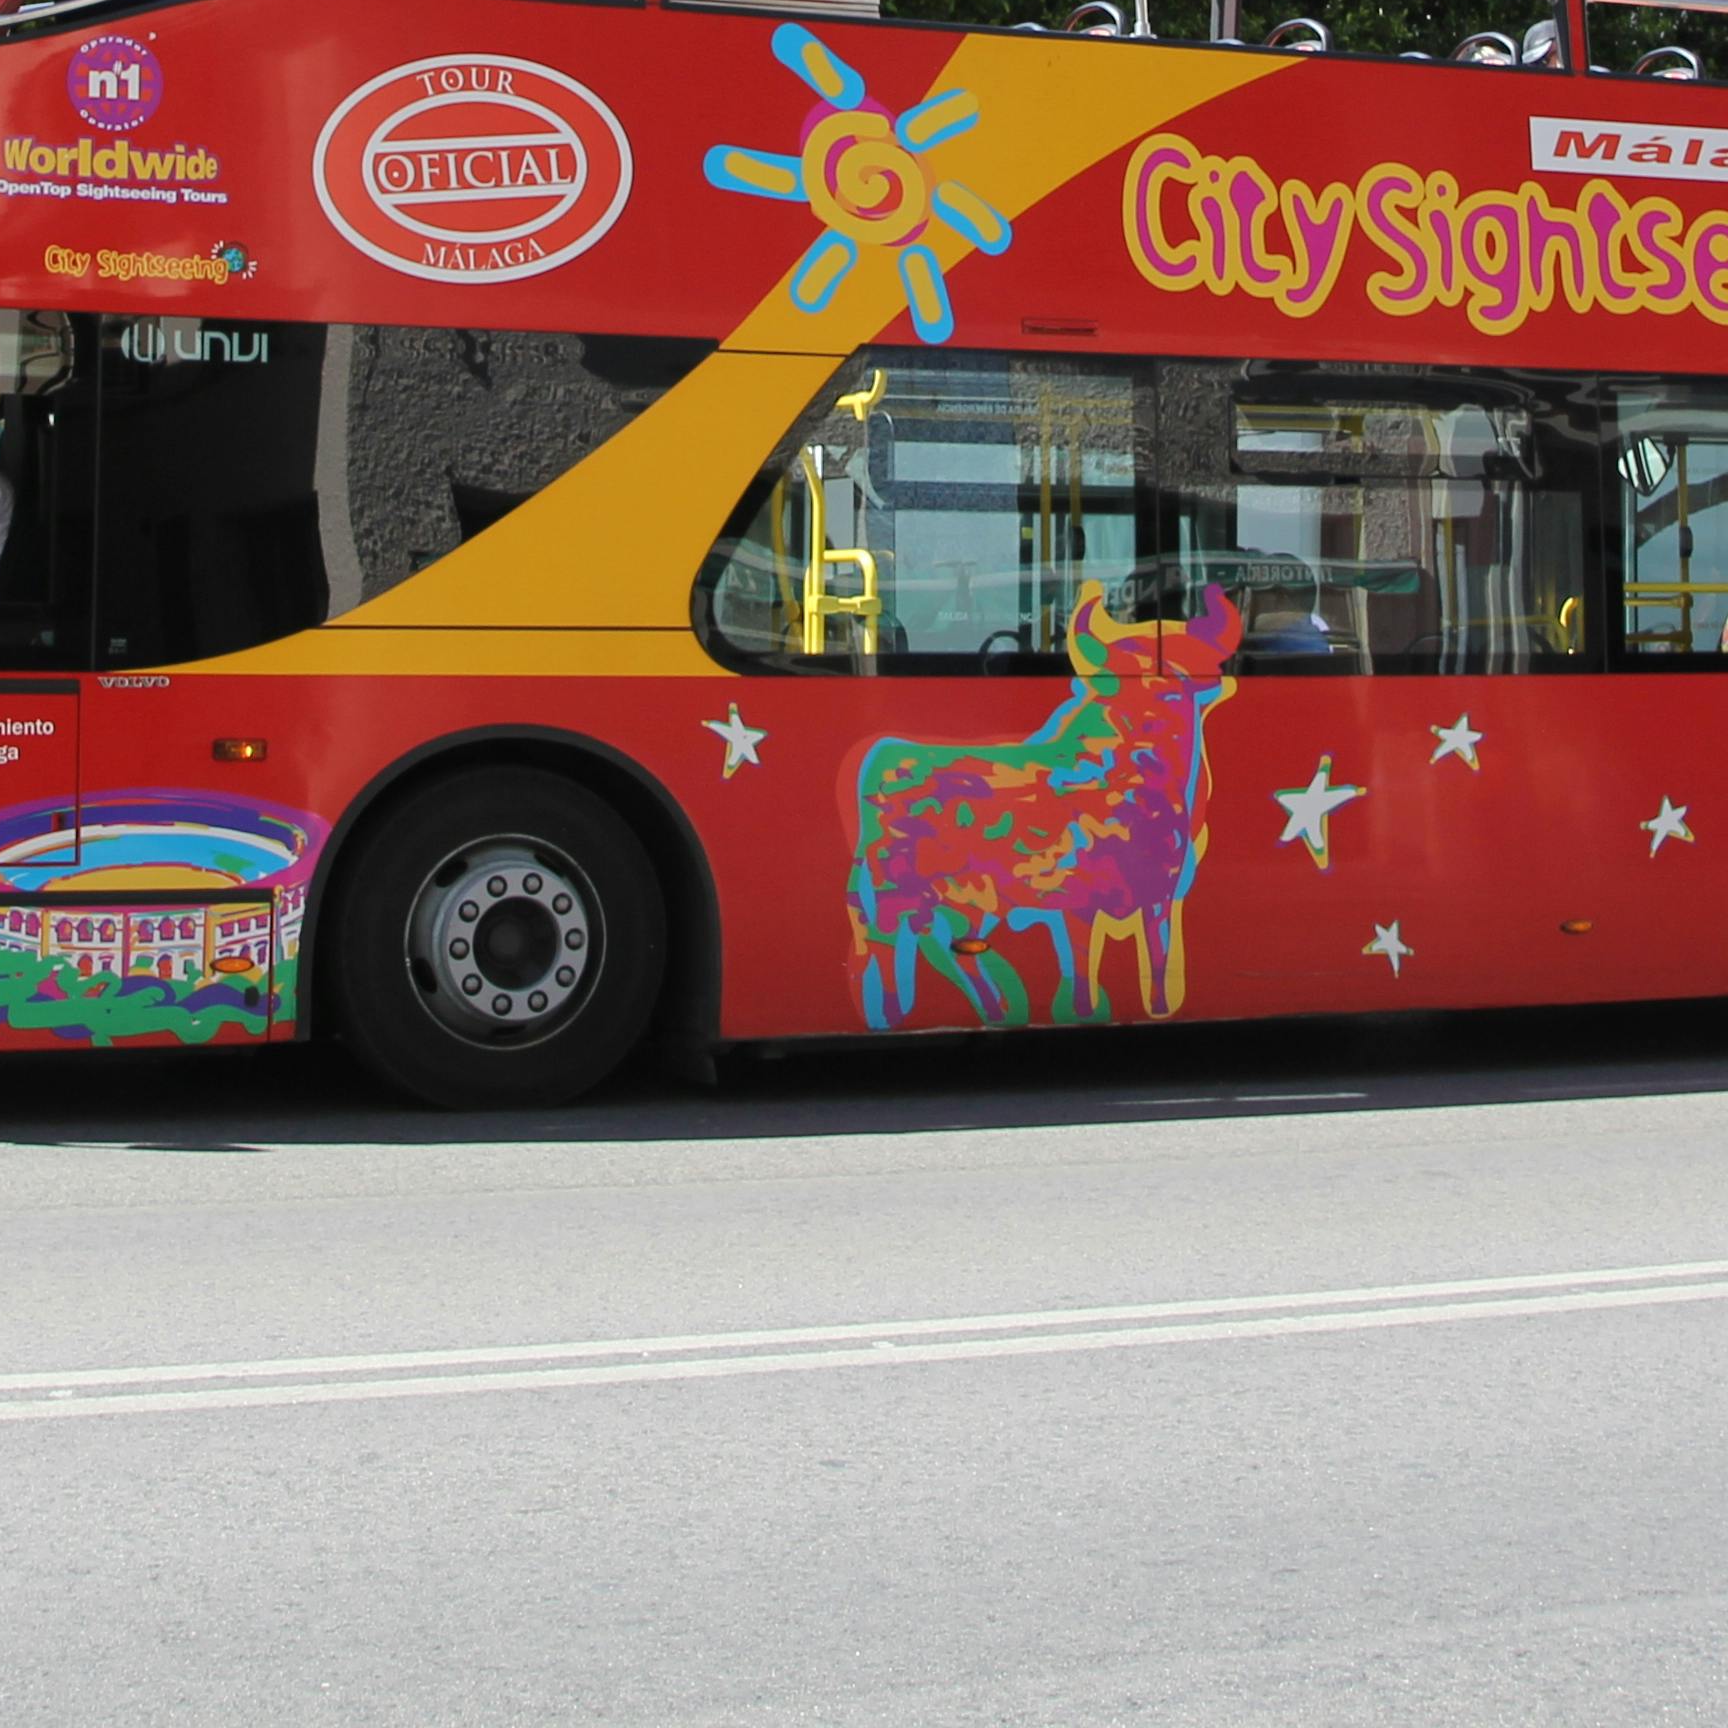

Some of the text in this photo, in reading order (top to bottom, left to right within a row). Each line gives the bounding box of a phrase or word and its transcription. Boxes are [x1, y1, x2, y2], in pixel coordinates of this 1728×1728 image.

[416, 67, 515, 97] TOUR
[5, 139, 218, 180] Worldwide
[378, 148, 572, 193] OFICIAL
[77, 183, 177, 203] Sightseeing
[180, 188, 227, 204] Tours
[45, 244, 229, 284] City Sightseeing
[422, 237, 547, 272] MÁLAGA
[97, 676, 170, 688] VOLVO
